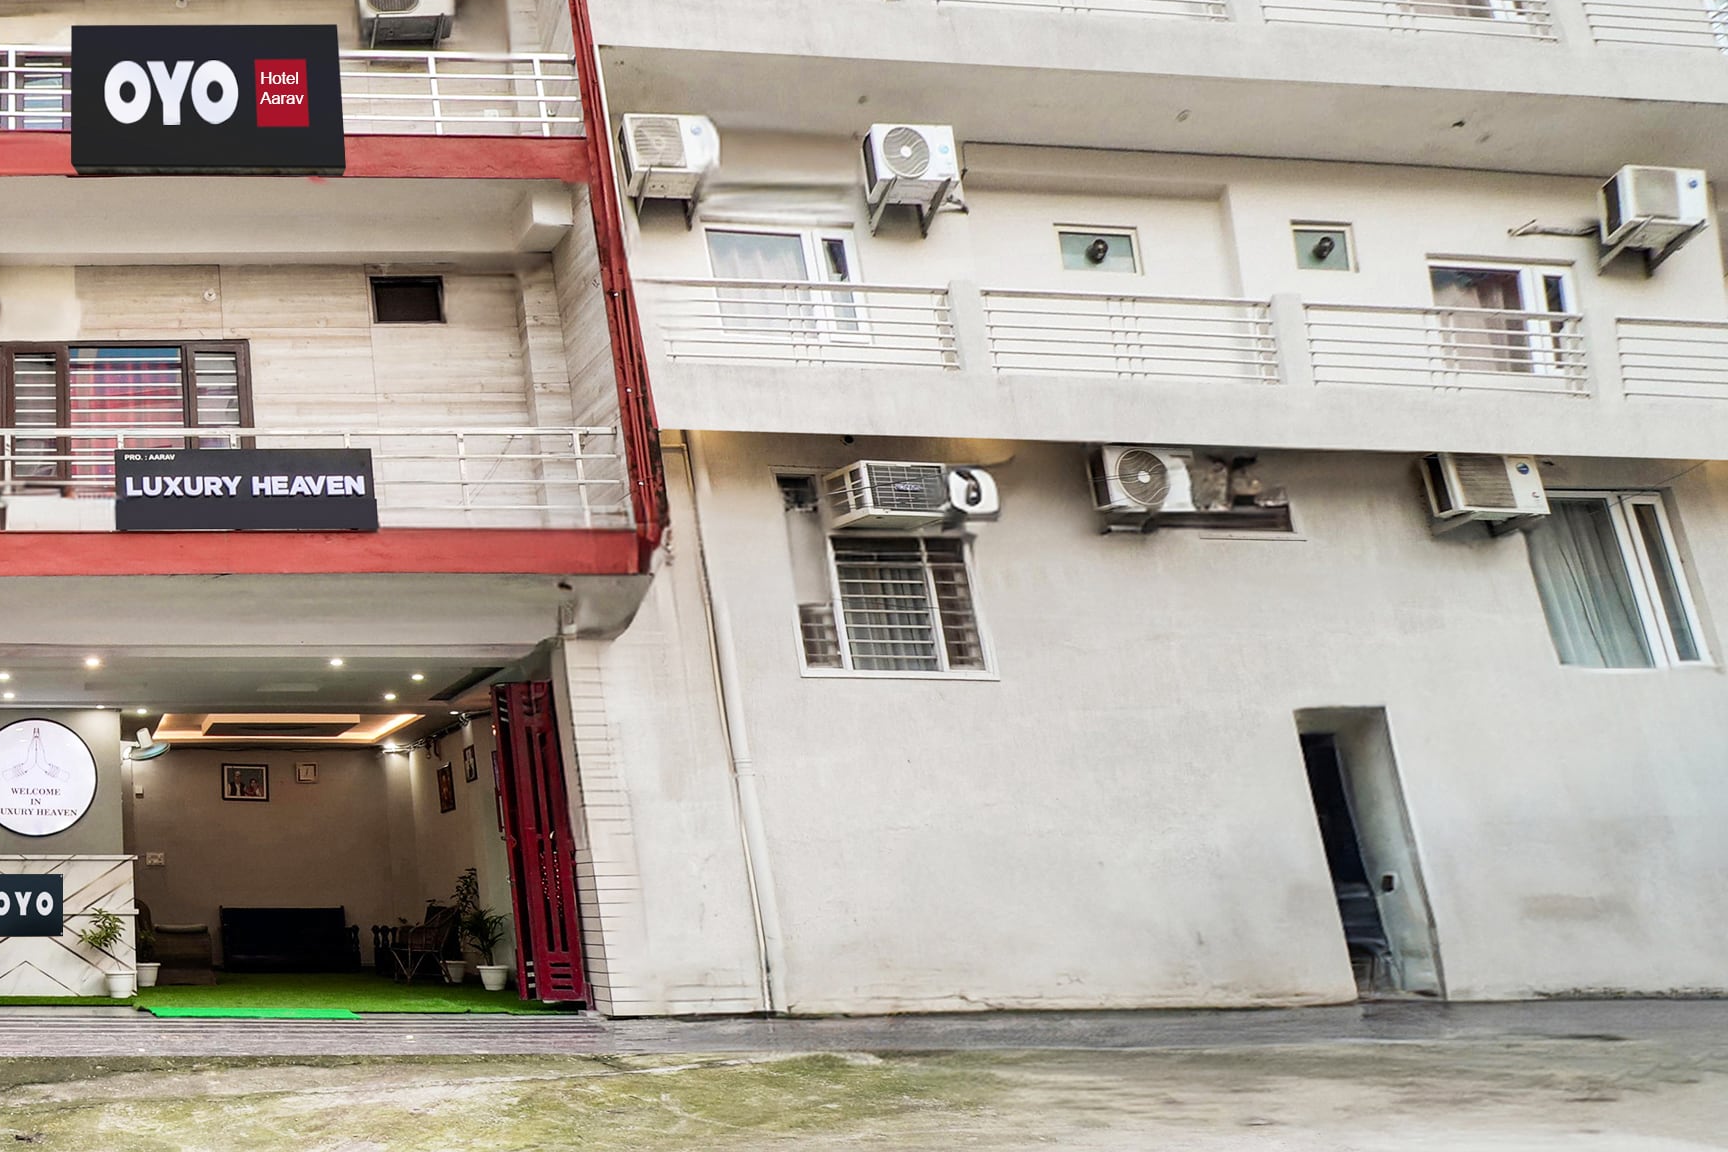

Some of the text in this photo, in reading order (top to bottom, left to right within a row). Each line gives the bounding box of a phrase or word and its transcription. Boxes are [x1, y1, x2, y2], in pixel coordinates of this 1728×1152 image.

[260, 71, 299, 85] Hotel
[104, 59, 239, 126] OYO
[260, 91, 304, 105] Aarav
[125, 475, 366, 498] LUXURY HEAVEN
[11, 787, 61, 795] WELCOME
